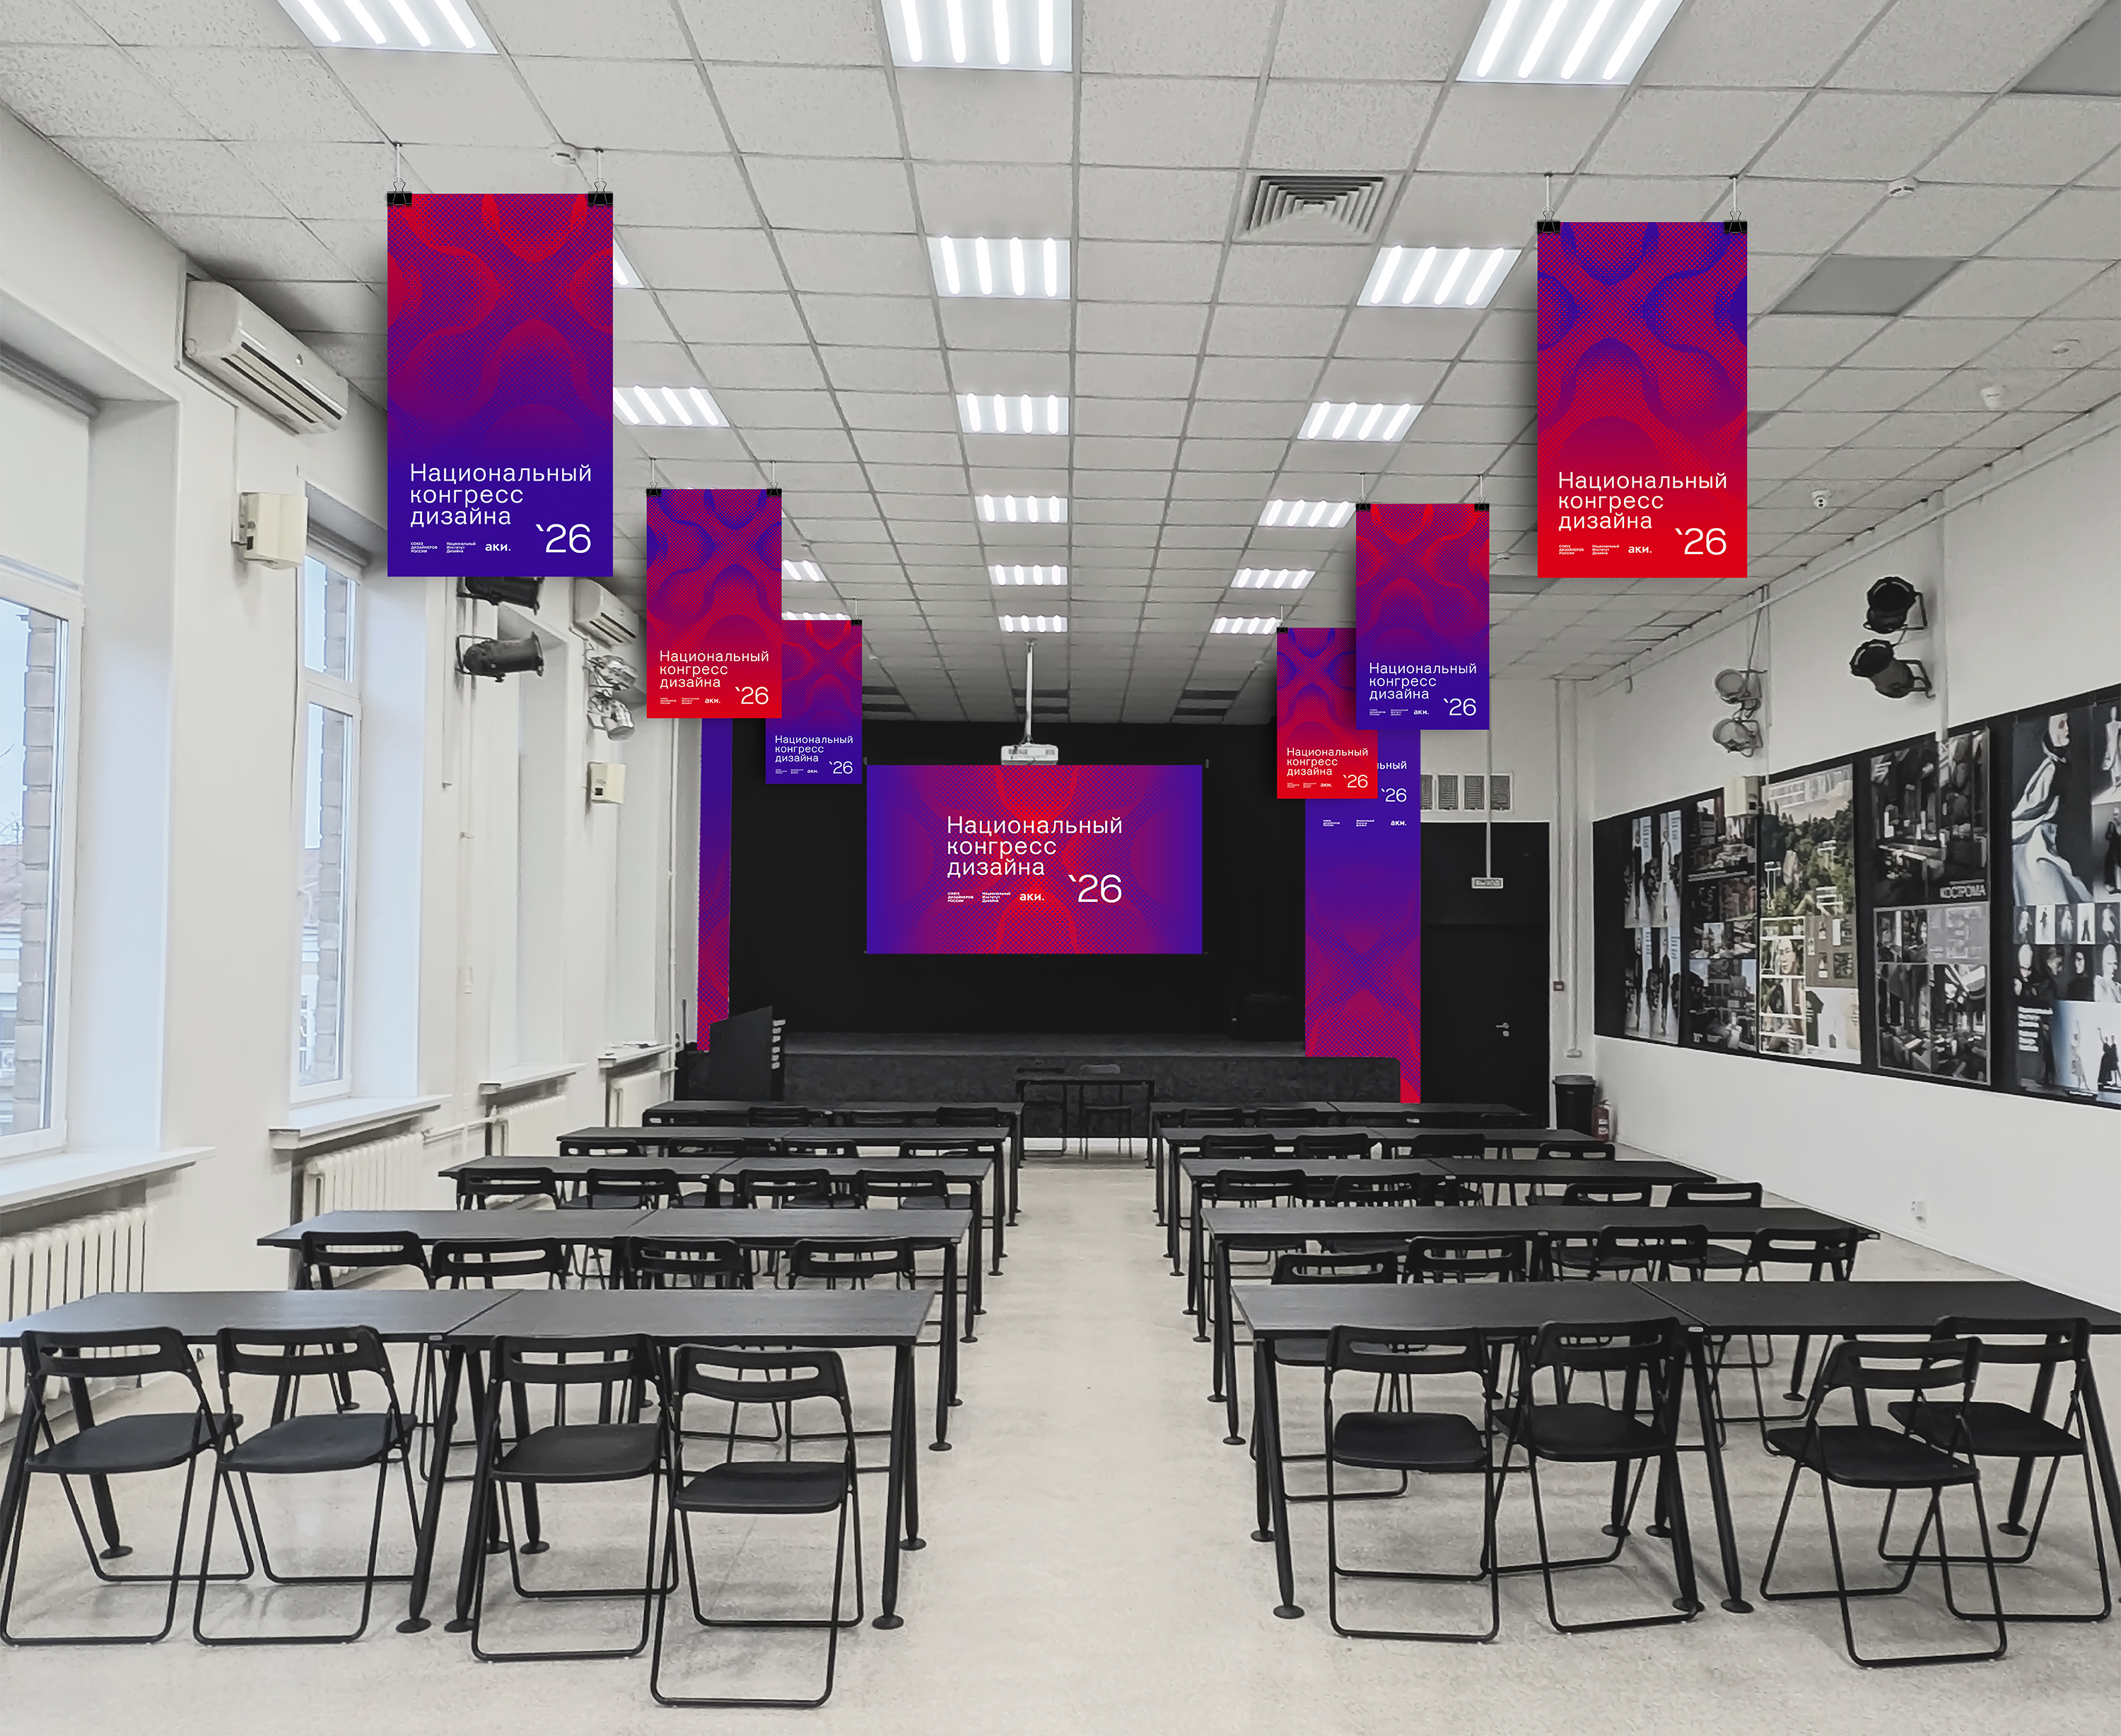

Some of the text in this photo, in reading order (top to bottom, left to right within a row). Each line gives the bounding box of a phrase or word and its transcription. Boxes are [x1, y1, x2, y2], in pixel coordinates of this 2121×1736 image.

[411, 464, 590, 484] Национальный
[1560, 472, 1726, 491] Национальный
[411, 489, 522, 508] конгресс
[1560, 496, 1663, 513] конгресс
[411, 508, 510, 527] дизайна
[1559, 511, 1652, 531] дизайна
[660, 650, 769, 663] Национальный
[660, 662, 728, 676] конгресс
[1370, 663, 1476, 675] Национальный
[660, 676, 720, 688] дизайна
[1370, 678, 1436, 688] конгресс
[1369, 688, 1429, 700] дизайна
[776, 735, 853, 744] Национальный
[776, 746, 824, 756] конгресс
[1287, 748, 1367, 757] Национальный
[776, 753, 818, 763] дизайна
[1287, 766, 1332, 776] дизайна
[948, 816, 1121, 836] Национальный
[948, 841, 1056, 860] конгресс
[947, 857, 1044, 878] дизайна
